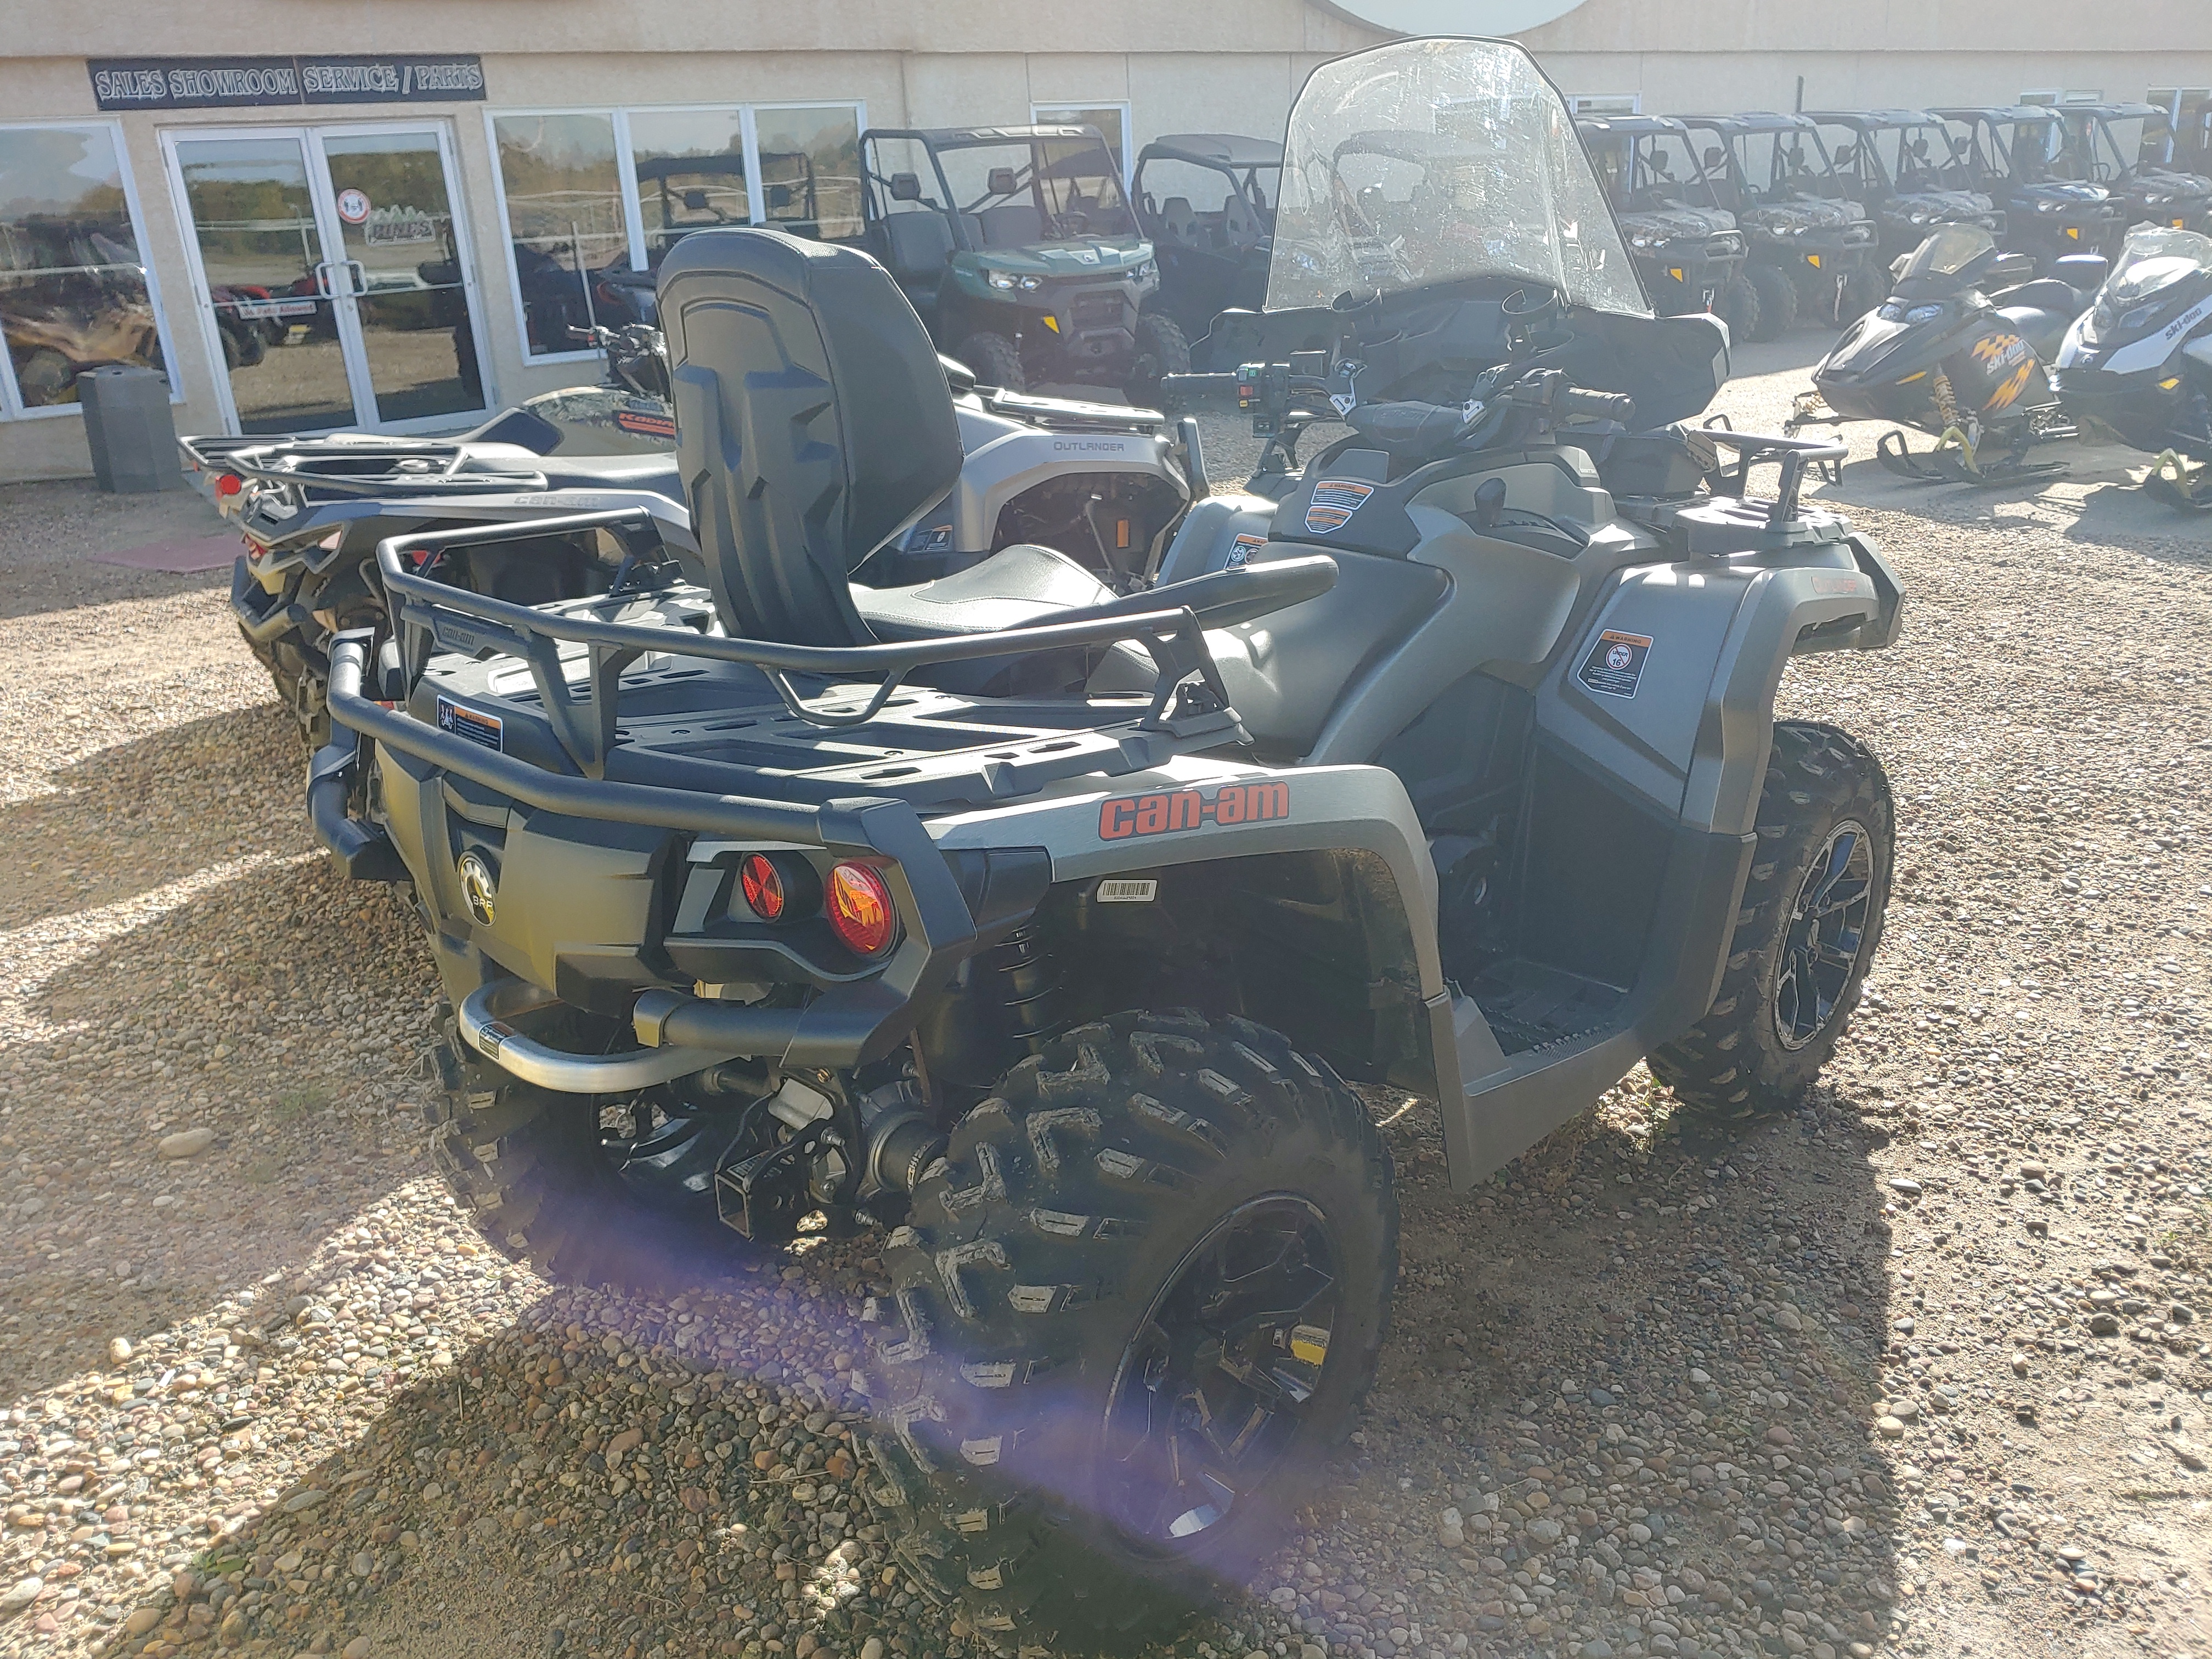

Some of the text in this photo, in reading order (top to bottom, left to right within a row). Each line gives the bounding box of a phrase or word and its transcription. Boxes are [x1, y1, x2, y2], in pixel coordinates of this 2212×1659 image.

[95, 68, 298, 102] SALES SHOWROOM
[302, 63, 483, 94] SERVICE / PARTS
[2165, 307, 2202, 340] ski-doo
[1986, 339, 2025, 375] ski-doo
[1053, 441, 1125, 452] OUTLANDER
[1615, 636, 1642, 644] WARNING
[1612, 658, 1622, 667] 16
[1098, 783, 1289, 841] can-am
[472, 895, 493, 910] BRP
